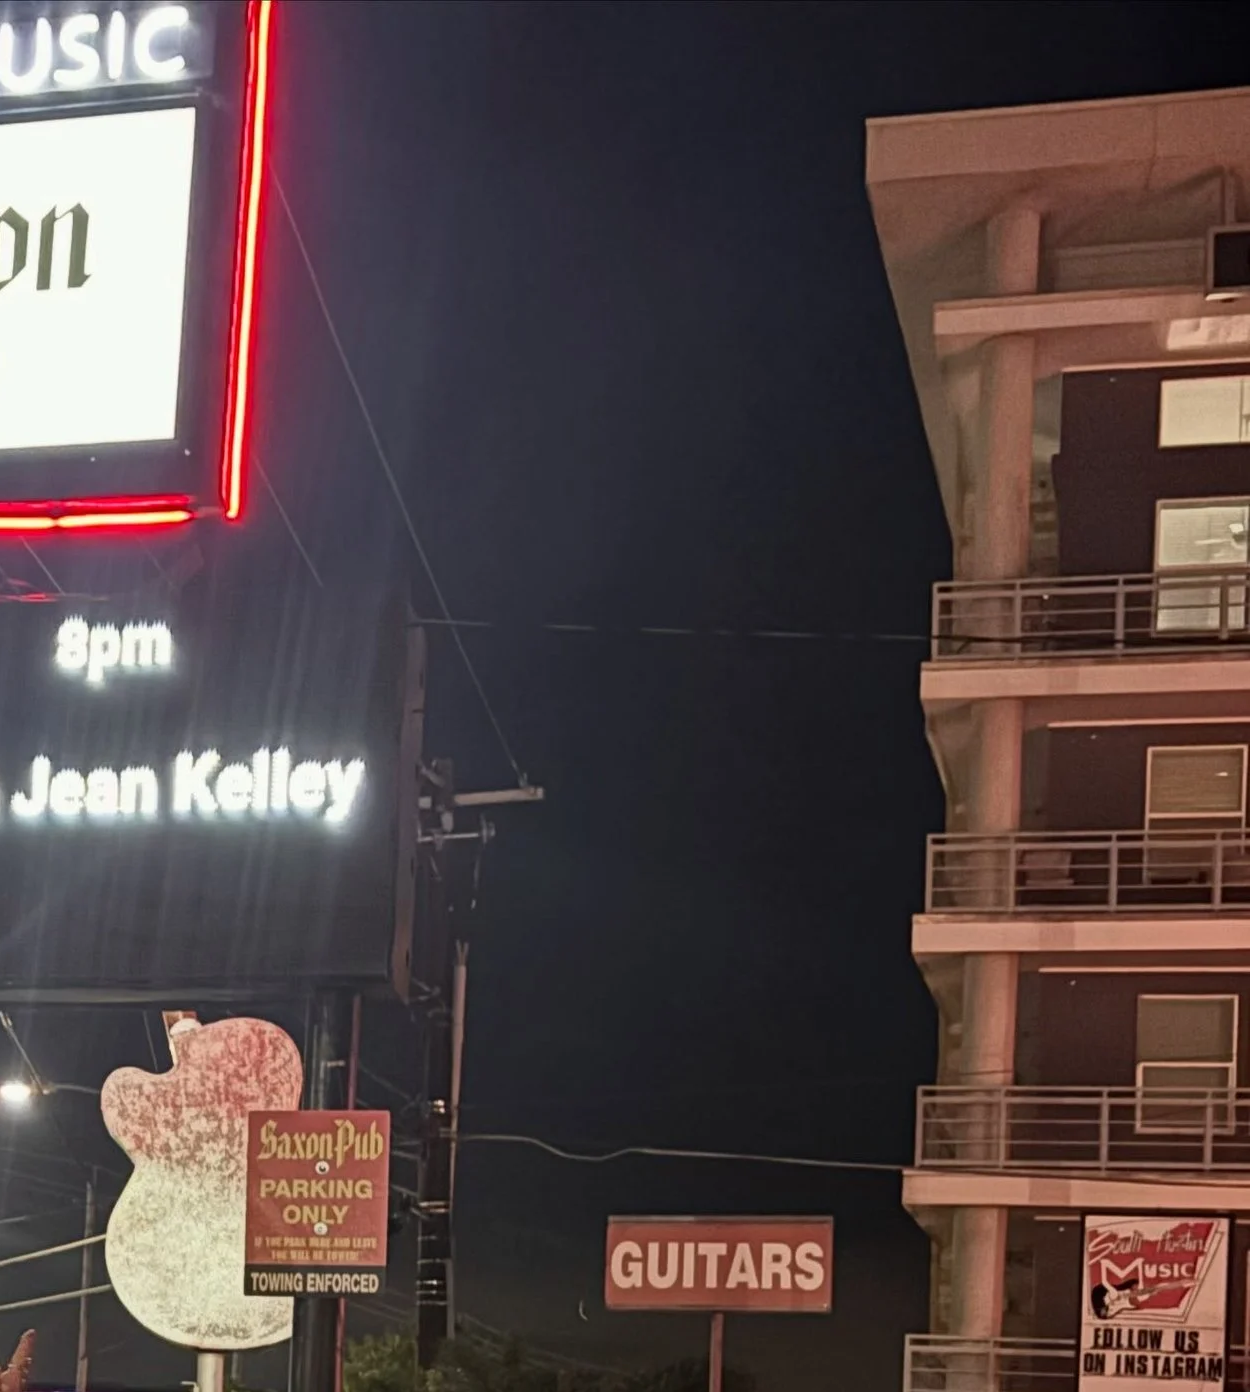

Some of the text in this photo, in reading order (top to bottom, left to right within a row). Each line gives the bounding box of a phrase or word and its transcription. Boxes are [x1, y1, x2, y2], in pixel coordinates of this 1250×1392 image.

[55, 614, 176, 685] 8pm
[10, 753, 160, 819] Jean
[171, 745, 367, 826] Kelley
[259, 1178, 374, 1200] PARKING
[282, 1204, 350, 1225] ONLY
[610, 1240, 825, 1291] GUITARS
[251, 1272, 380, 1294] TOWING ENFORCED
[1092, 1327, 1200, 1354] FOLLOW US
[1083, 1353, 1223, 1380] ON INSTAGRAM
